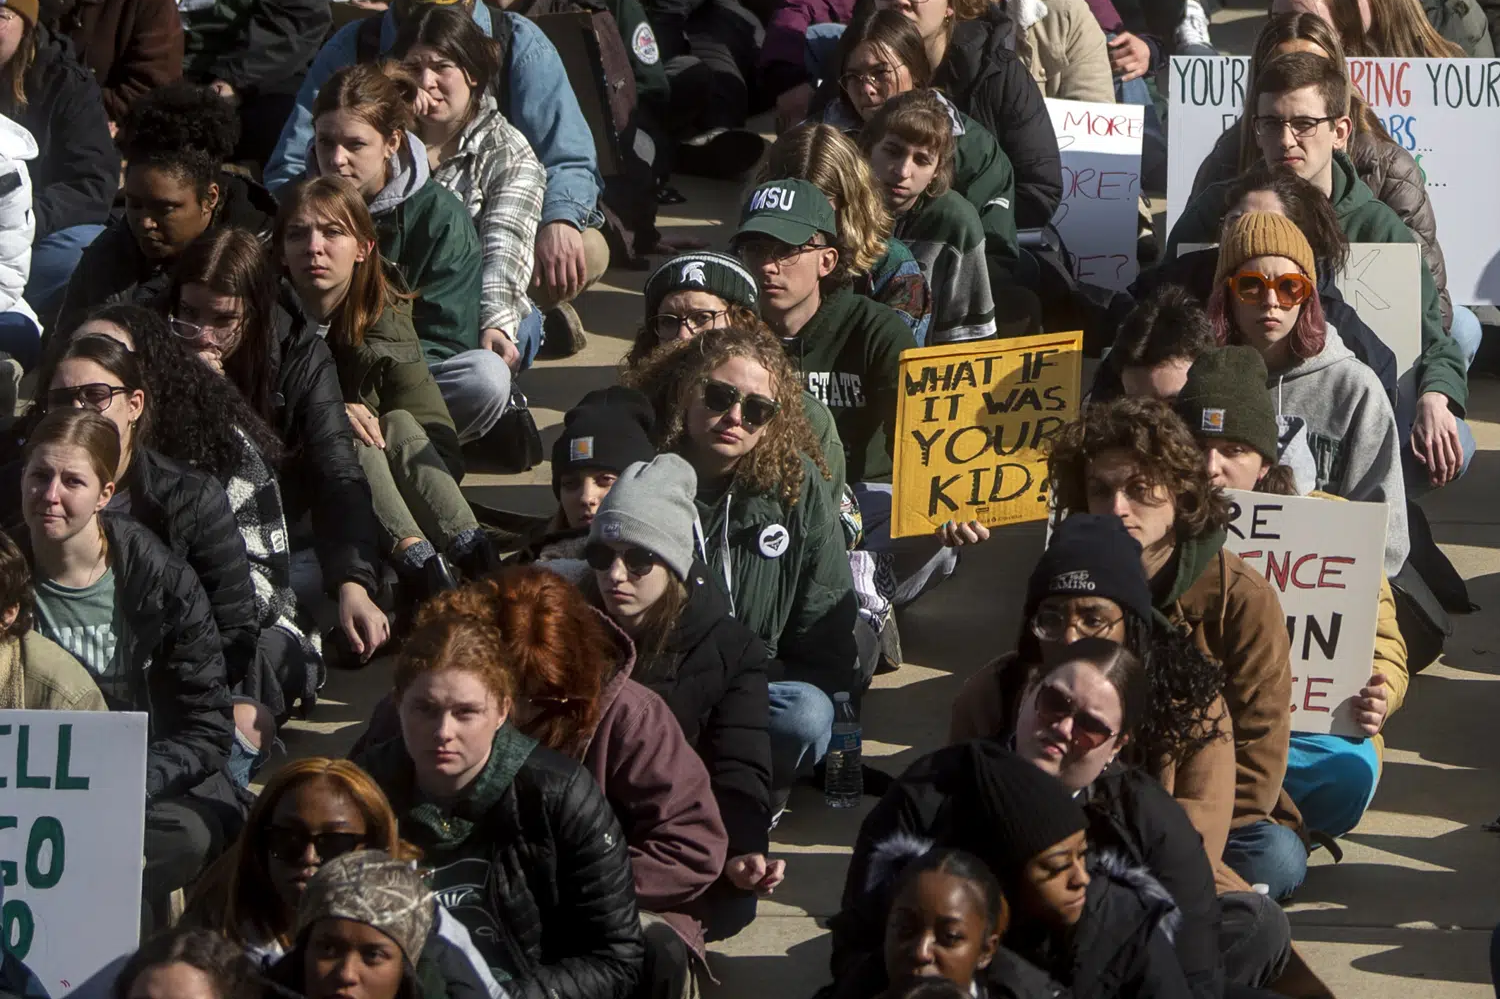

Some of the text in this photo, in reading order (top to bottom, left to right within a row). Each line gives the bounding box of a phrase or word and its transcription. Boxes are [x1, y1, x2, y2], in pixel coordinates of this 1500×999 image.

[1173, 58, 1251, 108] YOU'R
[1350, 61, 1411, 107] RING
[750, 186, 796, 212] MSU
[808, 372, 867, 407] STATE
[905, 349, 1059, 397] WHAT IF
[921, 386, 1066, 423] IT WAS
